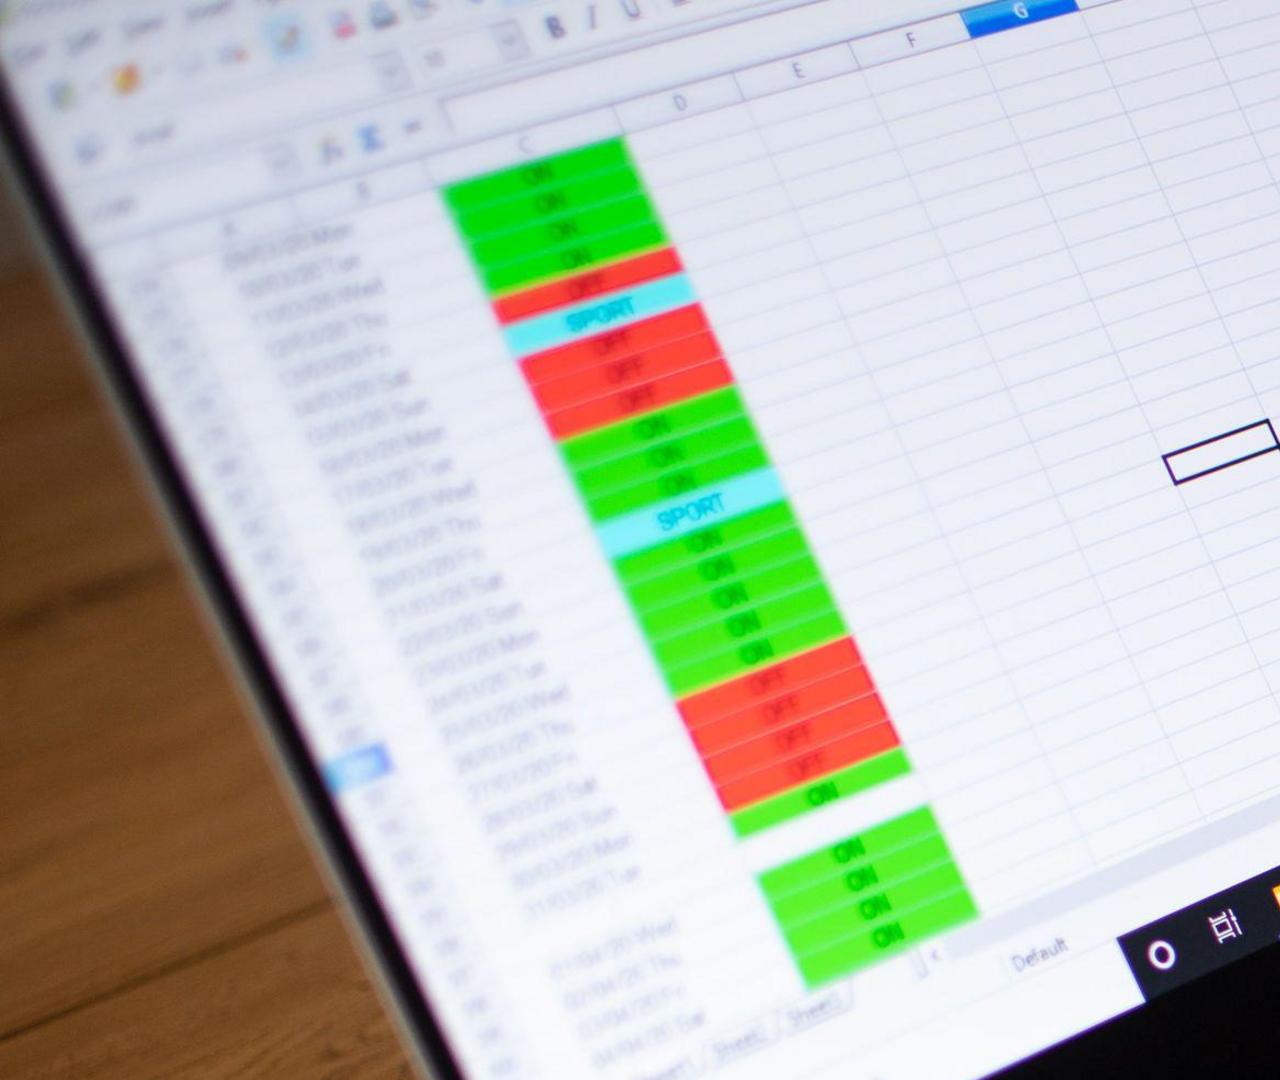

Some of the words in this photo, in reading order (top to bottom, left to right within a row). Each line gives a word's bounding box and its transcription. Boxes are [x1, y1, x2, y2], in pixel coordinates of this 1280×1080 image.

[791, 61, 806, 79] E
[906, 32, 917, 48] F
[565, 297, 634, 333] SPORT
[606, 354, 644, 385] OFF
[620, 384, 657, 413] OFF
[632, 415, 672, 440] ON
[646, 443, 684, 468] ON
[658, 472, 696, 497] ON
[657, 492, 725, 531] SPORT
[686, 527, 722, 553] ON
[700, 554, 736, 581] ON
[711, 582, 748, 609] ON
[726, 610, 761, 637] ON
[739, 638, 774, 665] ON
[748, 667, 785, 696] OFF
[762, 696, 798, 726] OFF
[776, 722, 811, 752] OFF
[788, 752, 823, 781] OFF
[807, 781, 839, 806] ON
[833, 837, 866, 864] ON
[846, 866, 879, 892] ON
[859, 894, 892, 921] ON
[872, 922, 905, 949] ON
[1010, 936, 1070, 974] Default
